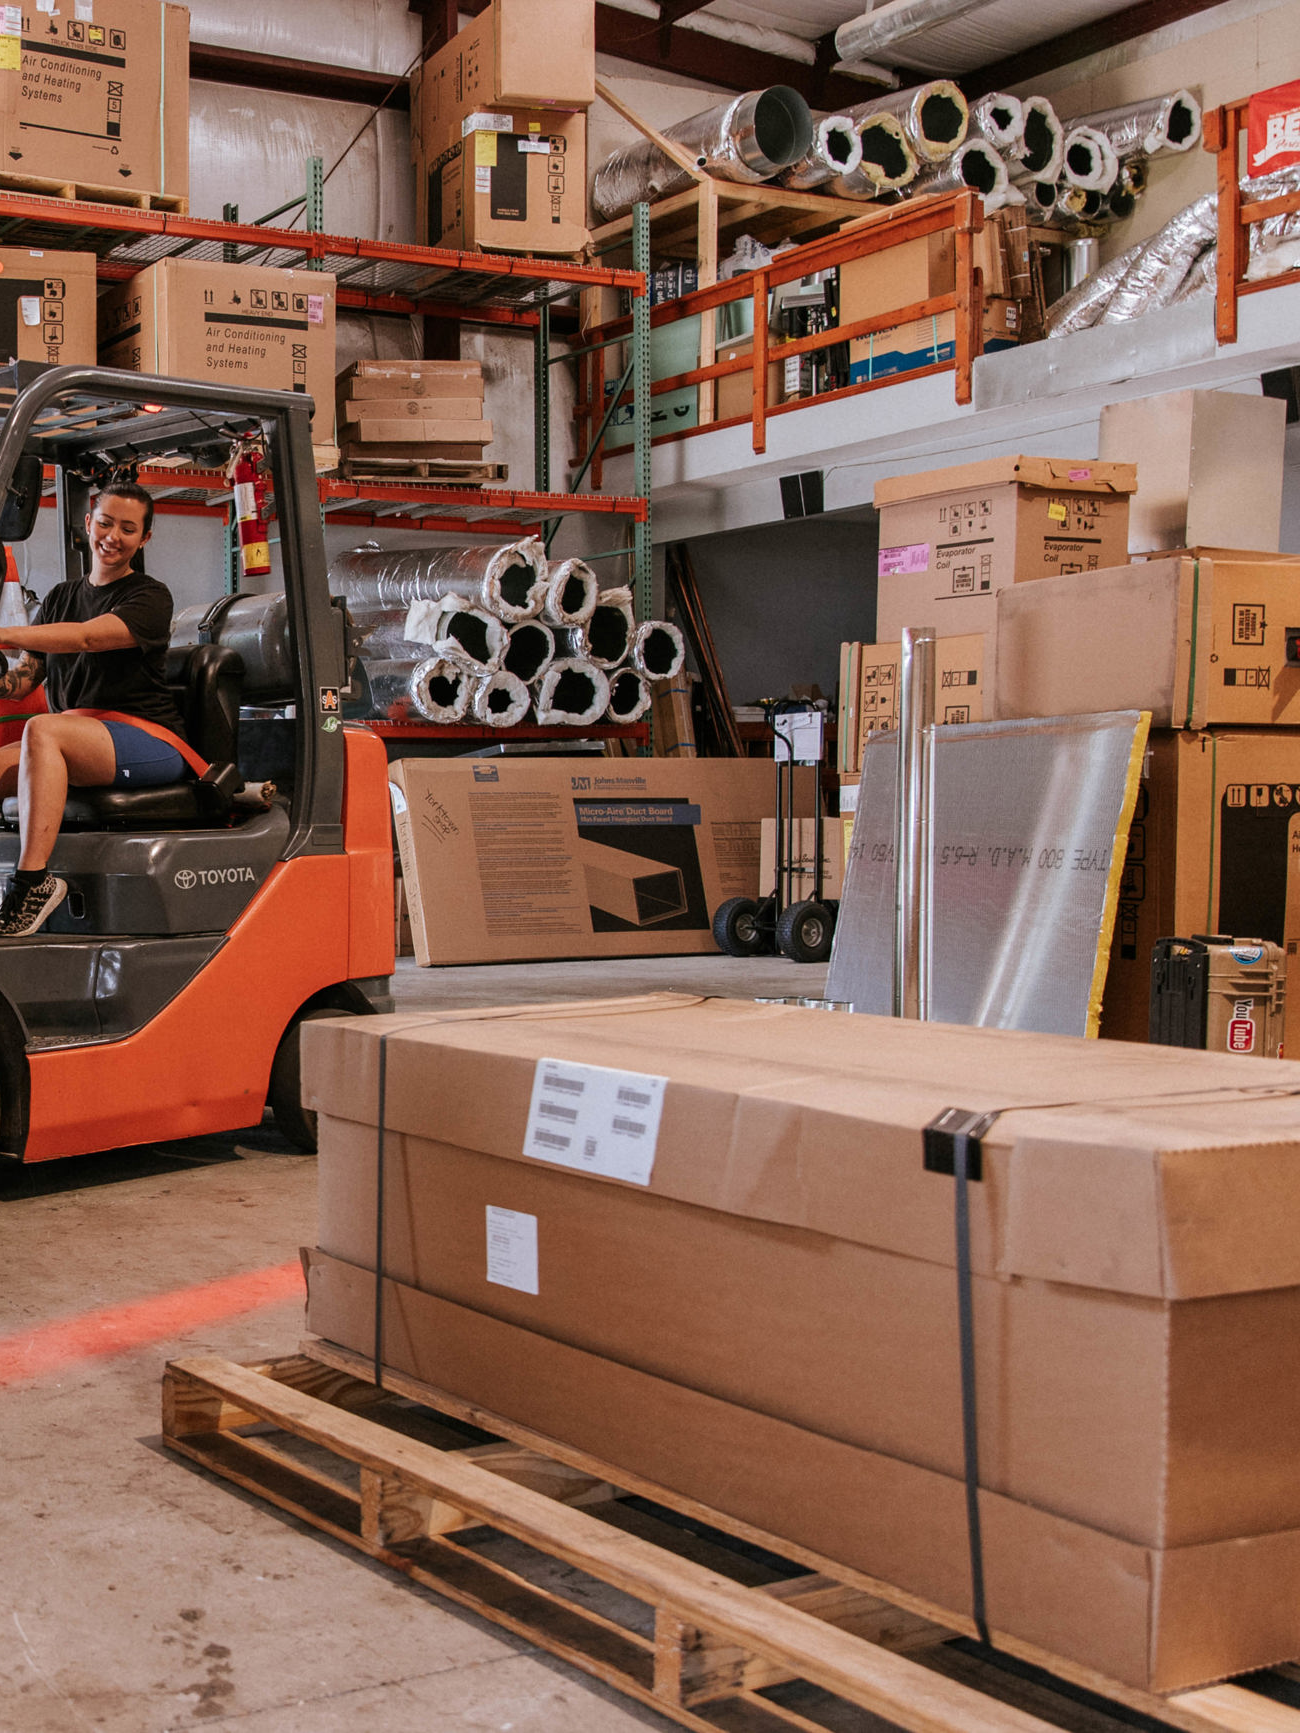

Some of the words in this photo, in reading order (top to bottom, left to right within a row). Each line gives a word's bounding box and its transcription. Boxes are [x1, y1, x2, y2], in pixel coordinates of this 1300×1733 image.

[22, 55, 36, 66] Air
[40, 57, 102, 81] Conditioning
[22, 71, 40, 83] and
[43, 74, 81, 93] Heating
[21, 85, 62, 103] Systems
[111, 101, 117, 109] 5
[205, 326, 221, 338] Air
[224, 328, 286, 344] Conditioning
[205, 343, 225, 353] and
[228, 344, 267, 358] Heating
[206, 357, 249, 370] Systems
[936, 546, 976, 559] Evaporator
[1044, 542, 1084, 552] Evaporator
[935, 561, 951, 570] Coil
[1044, 553, 1059, 563] Coil
[626, 807, 646, 815] Duct
[648, 807, 673, 816] Board
[940, 846, 979, 867] R-6.5
[1038, 848, 1065, 869] 800
[1070, 848, 1107, 871] TYPE
[198, 867, 255, 885] TOYOTA
